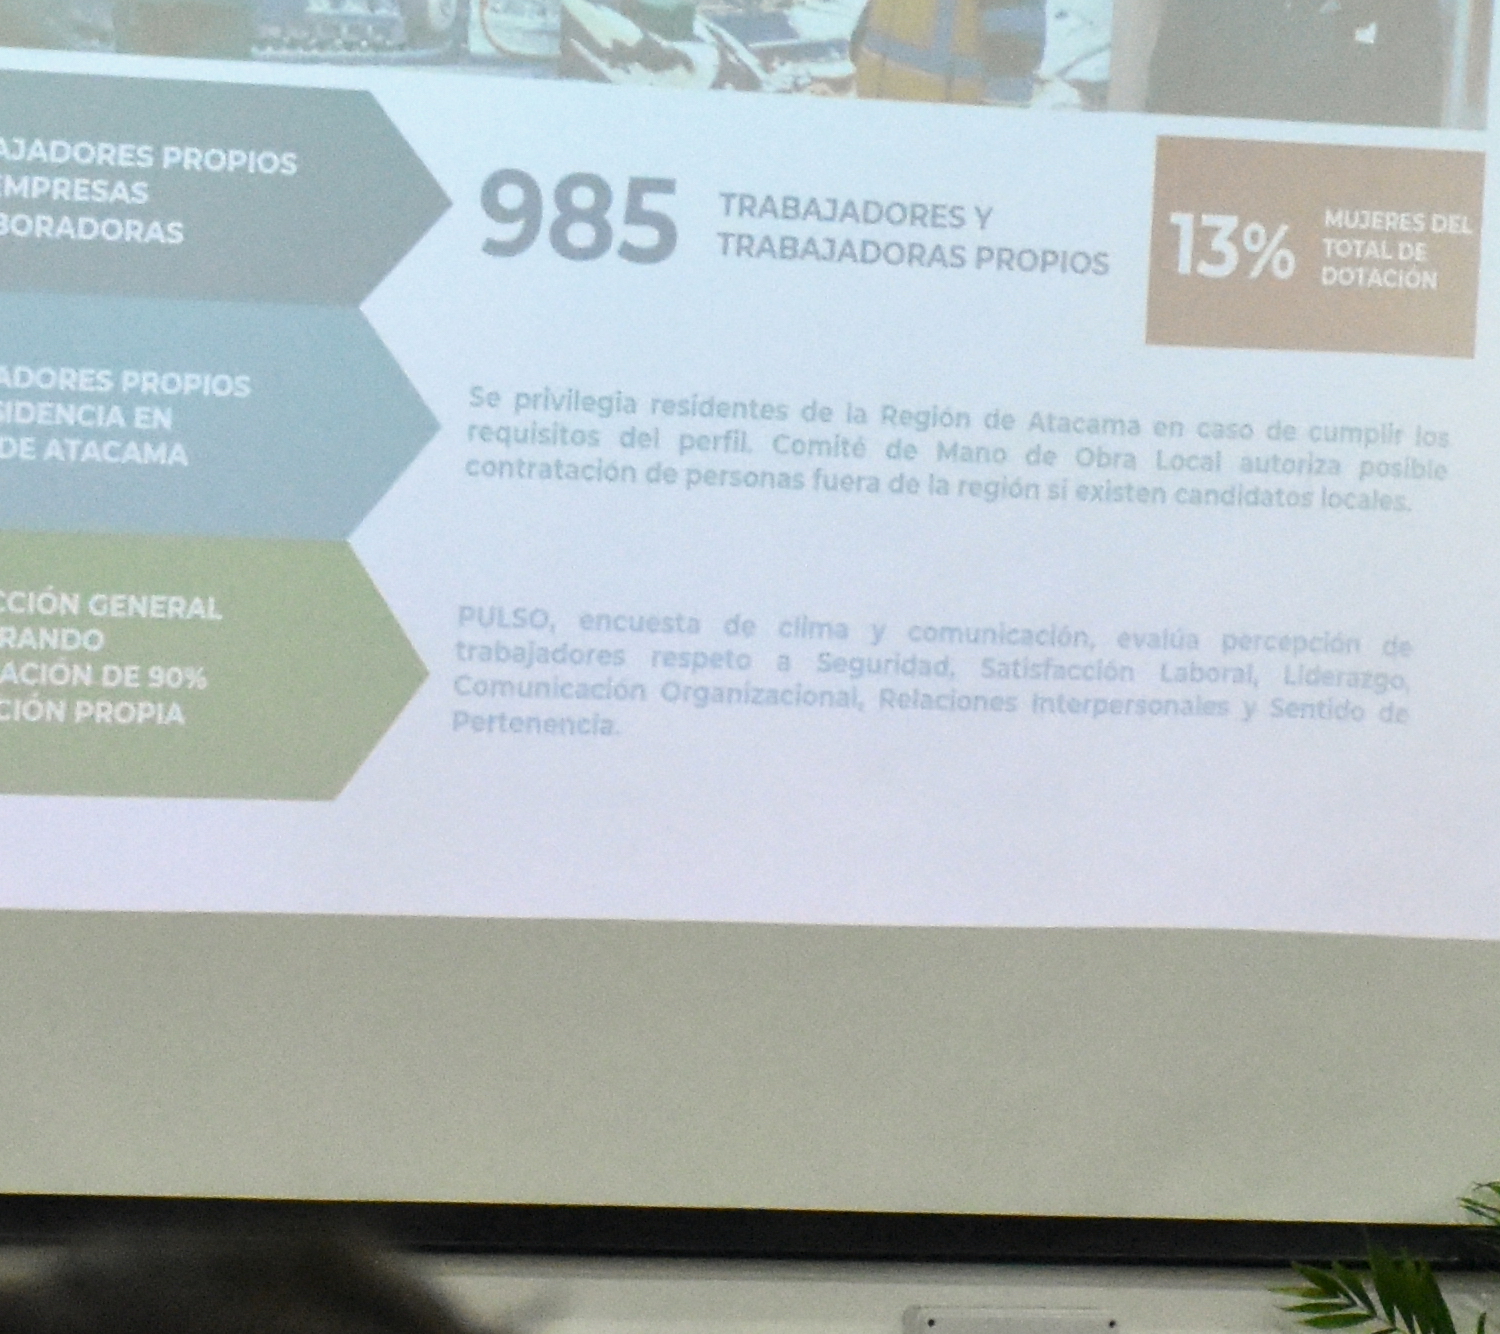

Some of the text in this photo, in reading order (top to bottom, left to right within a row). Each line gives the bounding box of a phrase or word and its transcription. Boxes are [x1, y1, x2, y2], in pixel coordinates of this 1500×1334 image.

[162, 144, 298, 177] PROPIOS
[480, 167, 678, 266] 985
[719, 190, 994, 232] TRABAJADORES Y
[1324, 208, 1474, 236] MUJERES DEL
[716, 230, 1110, 277] TRABAJADORAS PROPIOS
[1169, 210, 1296, 280] 13%
[1322, 236, 1428, 263] TOTAL DE
[1320, 264, 1438, 291] DOTACIÓN
[121, 368, 252, 399] PROPIOS
[133, 404, 173, 431] EN
[469, 384, 1450, 450] Se privilegia residentes de la Región de Atacama en caso de cumplir los
[42, 436, 189, 467] ATACAMA
[466, 419, 1448, 483] requisitos del perfil. Comité de Mano de Obra Local autoriza posible
[464, 456, 1412, 514] contratación de personas fuera de la región si existen candidatos locales.
[87, 592, 223, 622] GENERAL
[457, 604, 1414, 661] PULSO, encuesta de clima y comunicación, evalúa percepción de
[100, 663, 141, 689] DE
[147, 664, 208, 691] 90%
[454, 639, 1410, 697] trabajadores respeto a Seguridad, Satisfacción Laboral, Liderazgo,
[73, 698, 186, 726] PROPIA
[452, 674, 1410, 725] Comunicación Organizacional, Relaciones Interpersonales y Sentido de
[451, 710, 620, 737] Pertenencia.
